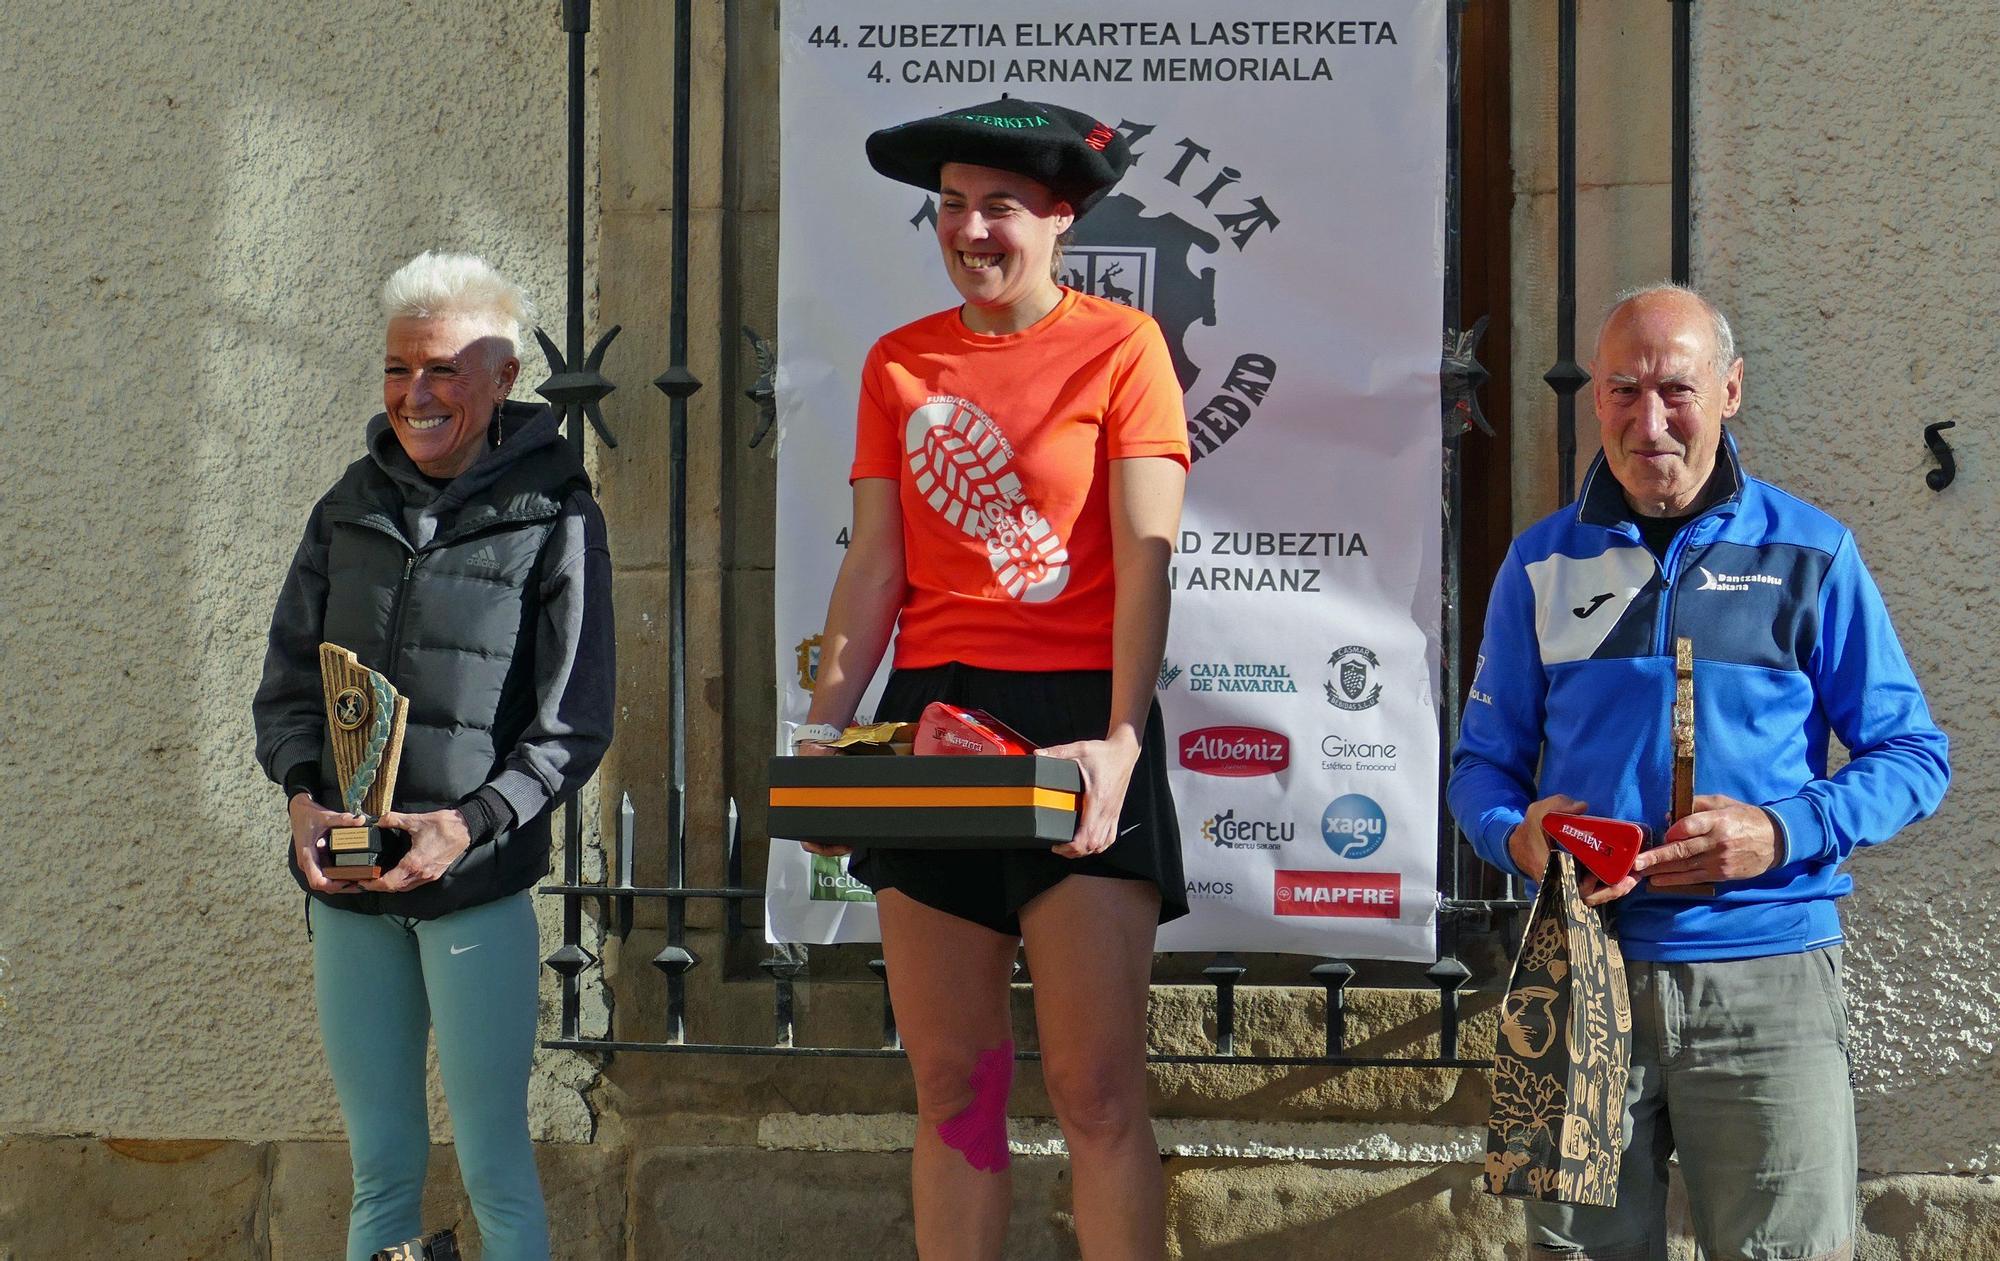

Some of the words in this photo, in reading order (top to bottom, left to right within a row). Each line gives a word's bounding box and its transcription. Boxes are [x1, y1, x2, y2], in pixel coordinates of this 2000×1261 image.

[807, 25, 848, 48] 44.
[858, 24, 1007, 48] ZUBEZTIA
[1016, 22, 1181, 47] ELKARTEA
[1190, 21, 1398, 46] LASTERKETA
[867, 60, 891, 83] 4.
[902, 60, 995, 83] CANDI
[1004, 58, 1133, 83] ARNANZ
[1143, 57, 1333, 82] MEMORIALA
[976, 487, 1027, 541] MOVE
[1211, 532, 1368, 556] ZUBEZTIA
[466, 558, 500, 569] adidas
[1186, 566, 1321, 592] ARNANZ
[1337, 646, 1370, 657] CASMAR
[1190, 664, 1232, 679] CAJA
[1234, 664, 1290, 678] RURAL
[1190, 678, 1213, 692] DE
[1218, 679, 1298, 693] NAVARRA
[1185, 735, 1283, 761] Albéniz
[1321, 735, 1396, 758] Gixane
[1355, 761, 1397, 772] Emocional
[1293, 887, 1394, 905] MAPFRE
